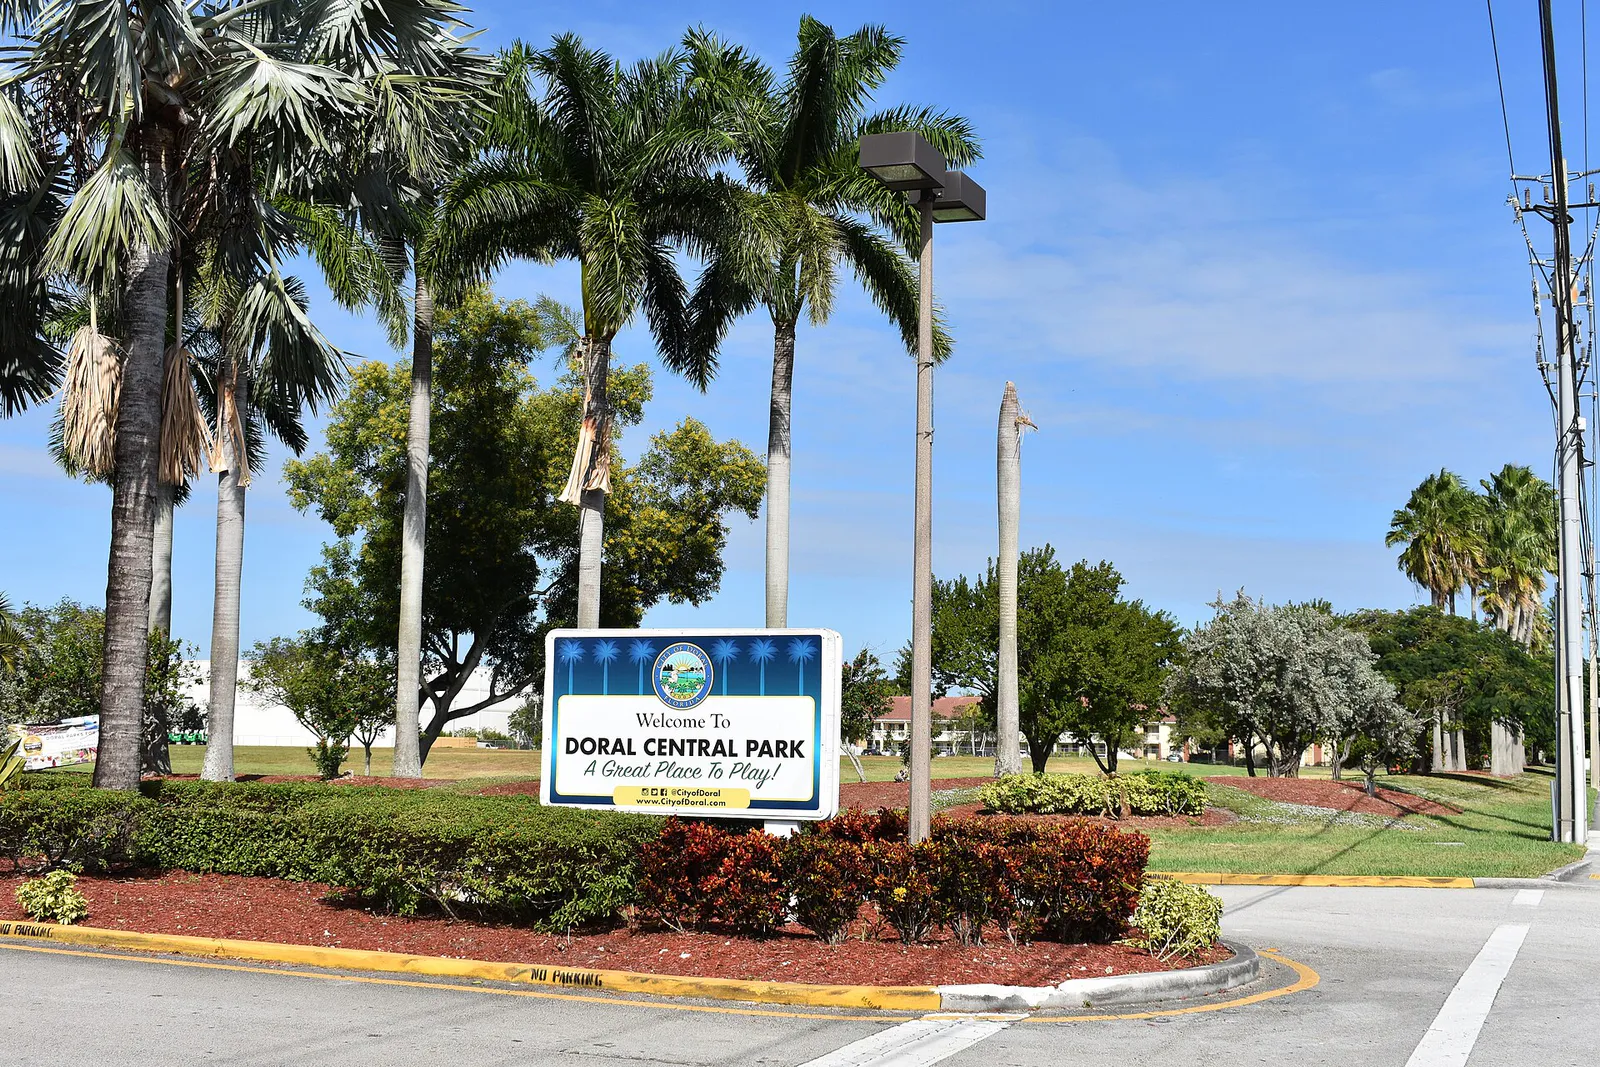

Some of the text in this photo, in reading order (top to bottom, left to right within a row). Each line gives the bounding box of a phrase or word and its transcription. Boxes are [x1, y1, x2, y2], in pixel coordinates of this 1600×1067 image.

[656, 645, 708, 669] CITY OF DORAL
[663, 695, 701, 707] FLORIDA
[636, 712, 731, 729] Welcome To
[565, 737, 805, 758] DORAL CENTRAL PARK
[583, 759, 782, 789] A Great Place To Play!
[671, 788, 721, 798] @CityofDoral
[636, 798, 726, 807] www.CityofDoral.com
[14, 924, 53, 938] PARKING
[530, 968, 603, 986] NO PARKING
